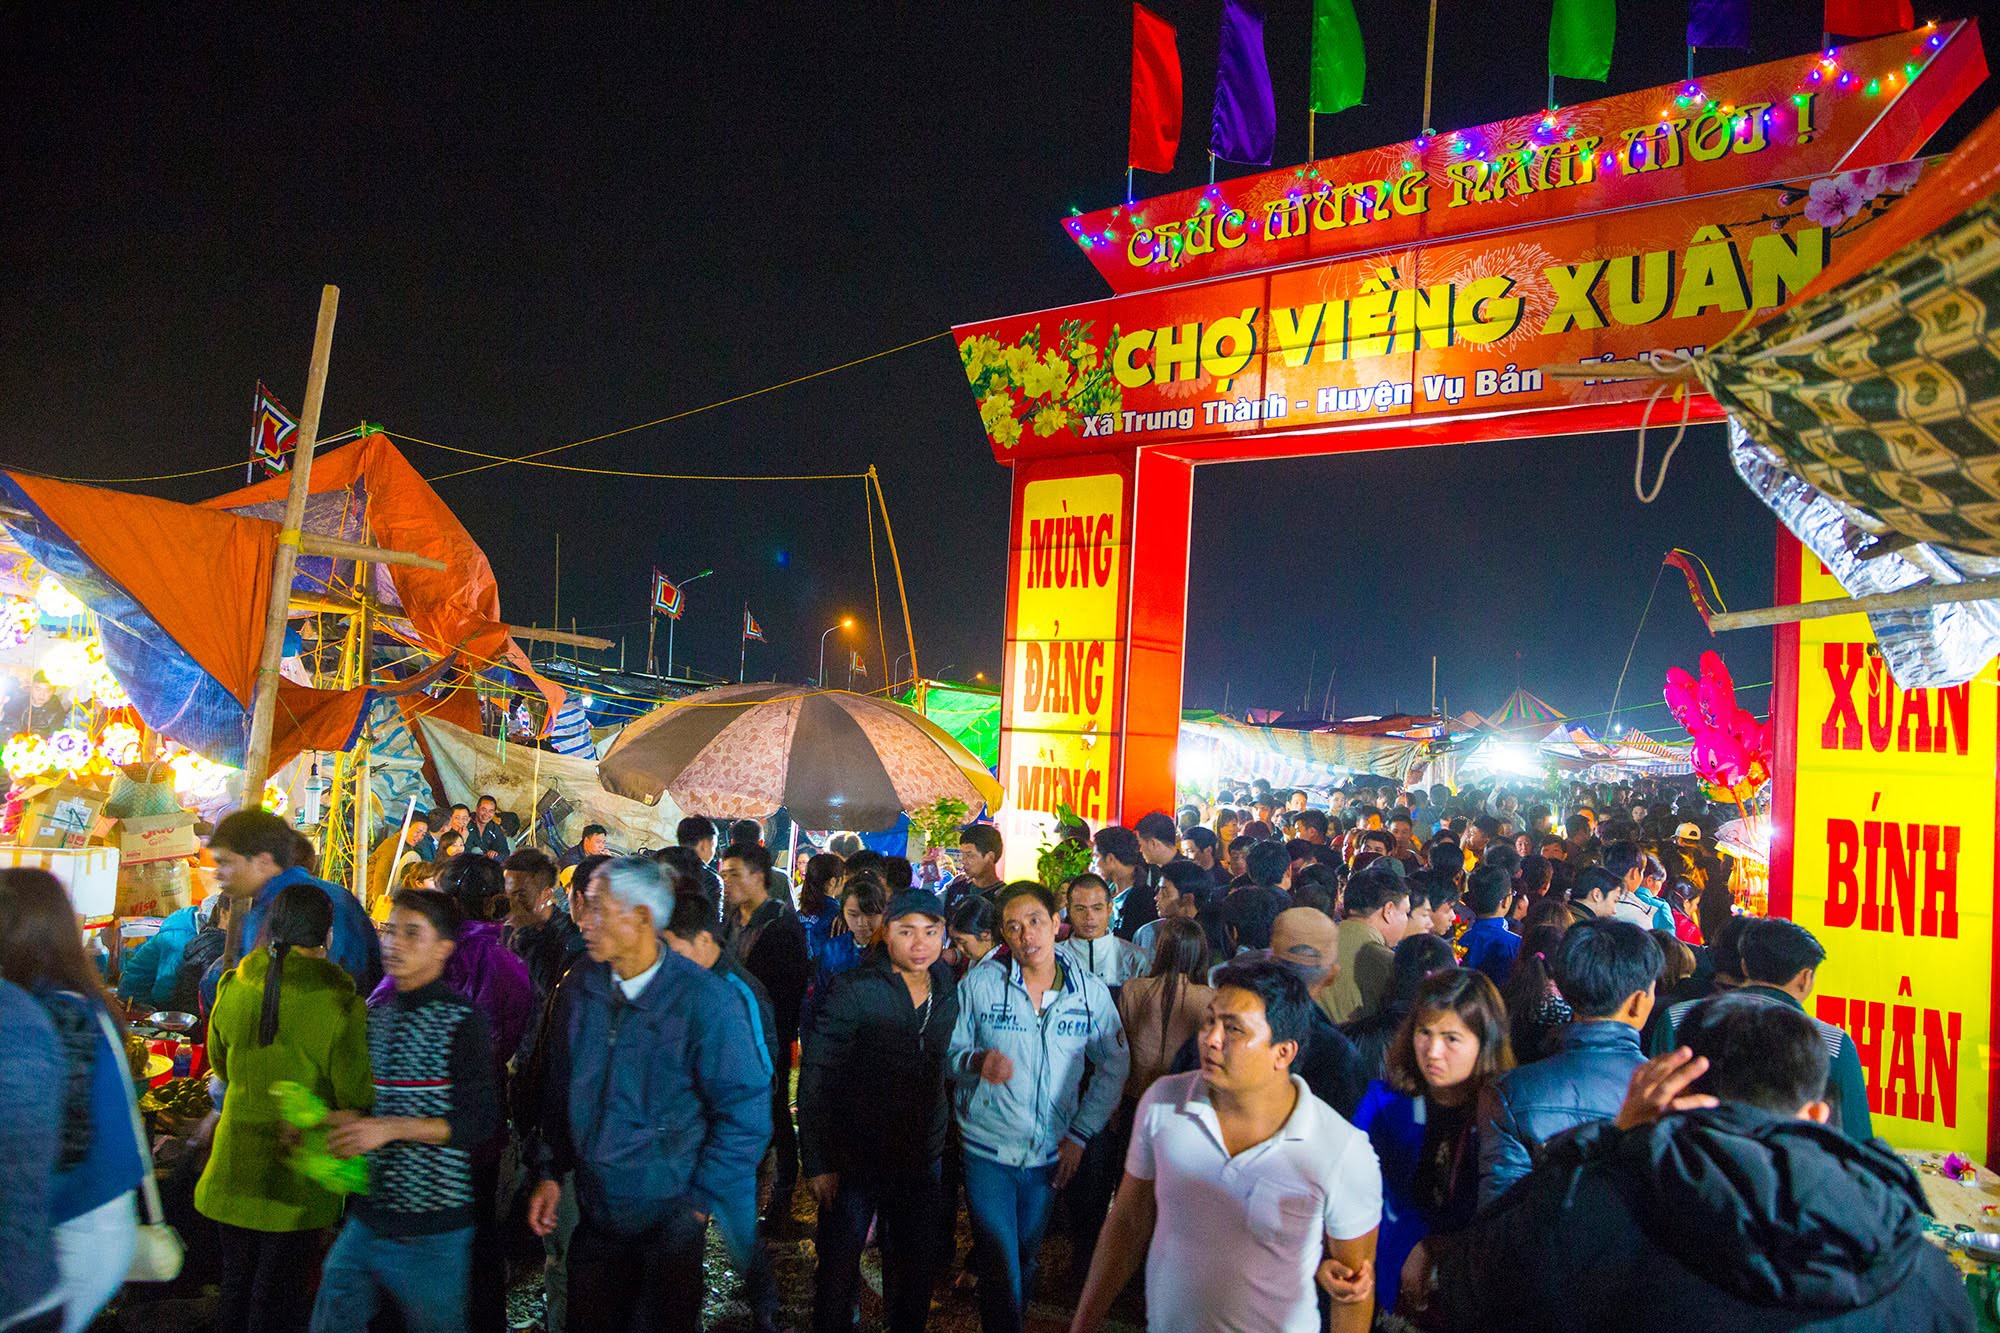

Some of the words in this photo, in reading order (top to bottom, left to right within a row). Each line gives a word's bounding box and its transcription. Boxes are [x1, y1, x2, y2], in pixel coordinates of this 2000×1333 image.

[1113, 307, 1260, 392] CHỢ
[1270, 267, 1526, 367] VIỀNG
[1540, 224, 1830, 335] XUÂN
[1082, 412, 1115, 438] Xã
[1121, 407, 1195, 433] Trung
[1202, 396, 1288, 425] Thành
[1316, 380, 1413, 413] Huyện
[1423, 374, 1465, 405] Vụ
[1475, 363, 1543, 397] Bản
[1027, 500, 1114, 589] MỪNG
[1023, 620, 1104, 715] ĐẢNG
[1824, 791, 1961, 939] BÍNH
